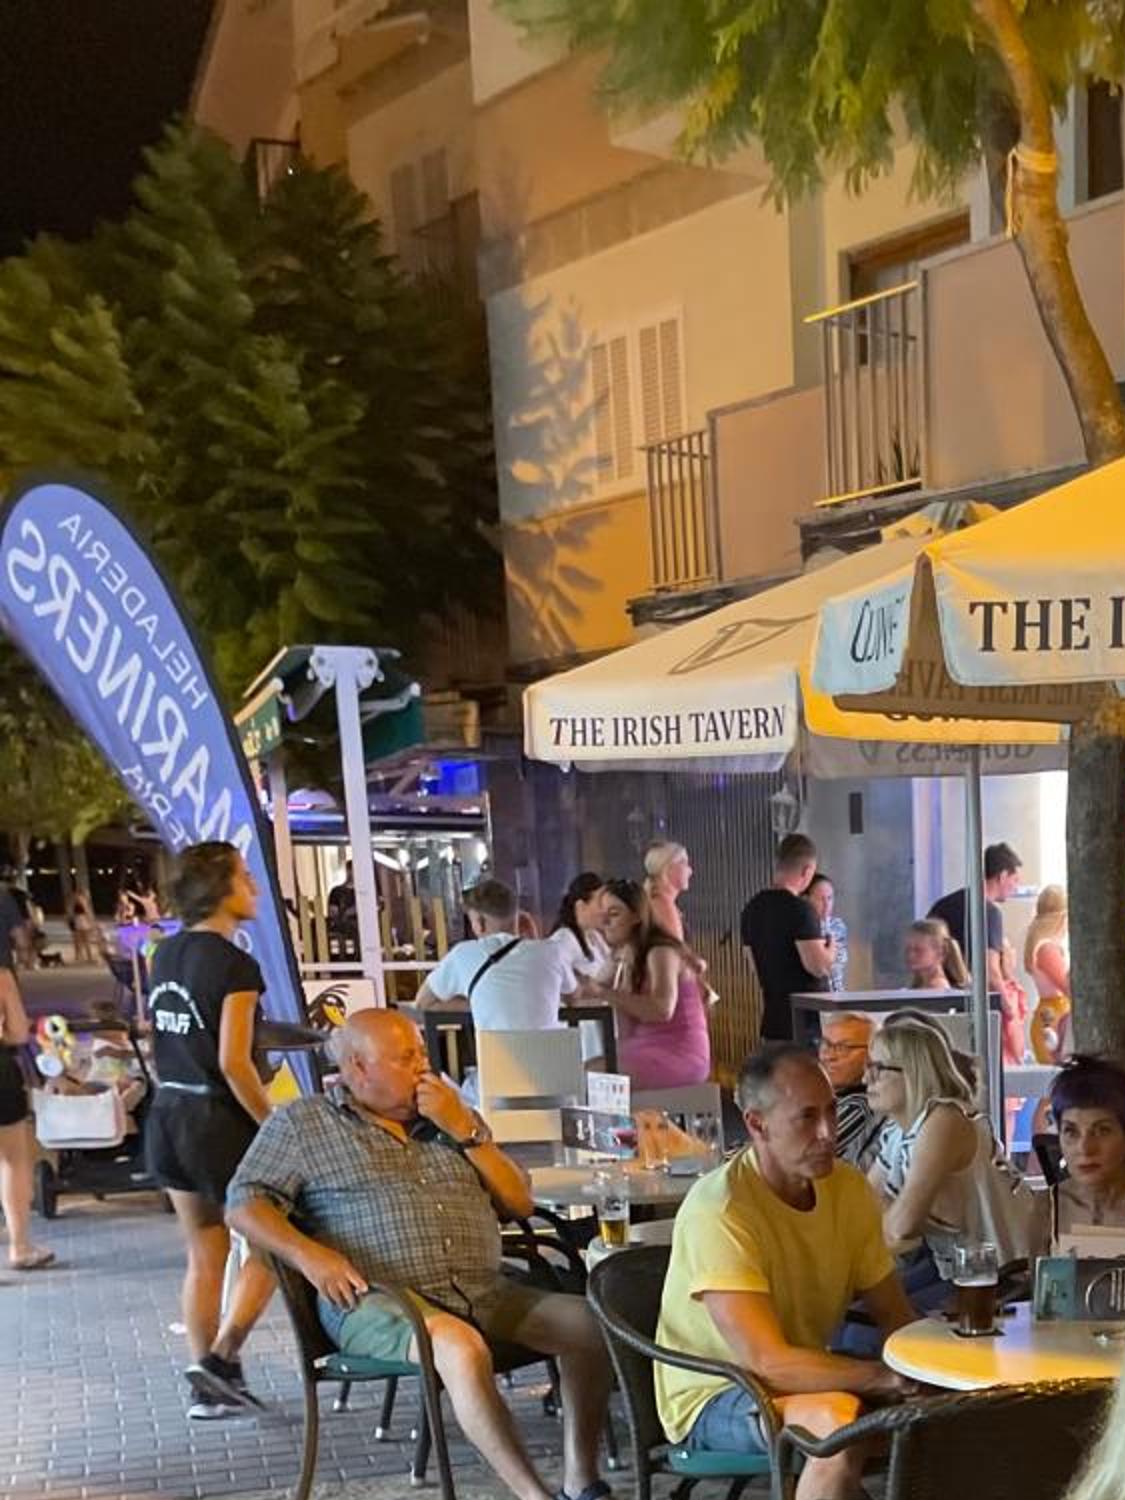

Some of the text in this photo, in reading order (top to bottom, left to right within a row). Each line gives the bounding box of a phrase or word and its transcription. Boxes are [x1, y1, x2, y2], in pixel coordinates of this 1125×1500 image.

[968, 598, 1091, 653] THE
[550, 703, 787, 748] THE IRISH TAVERN
[155, 1009, 192, 1035] STAFF
